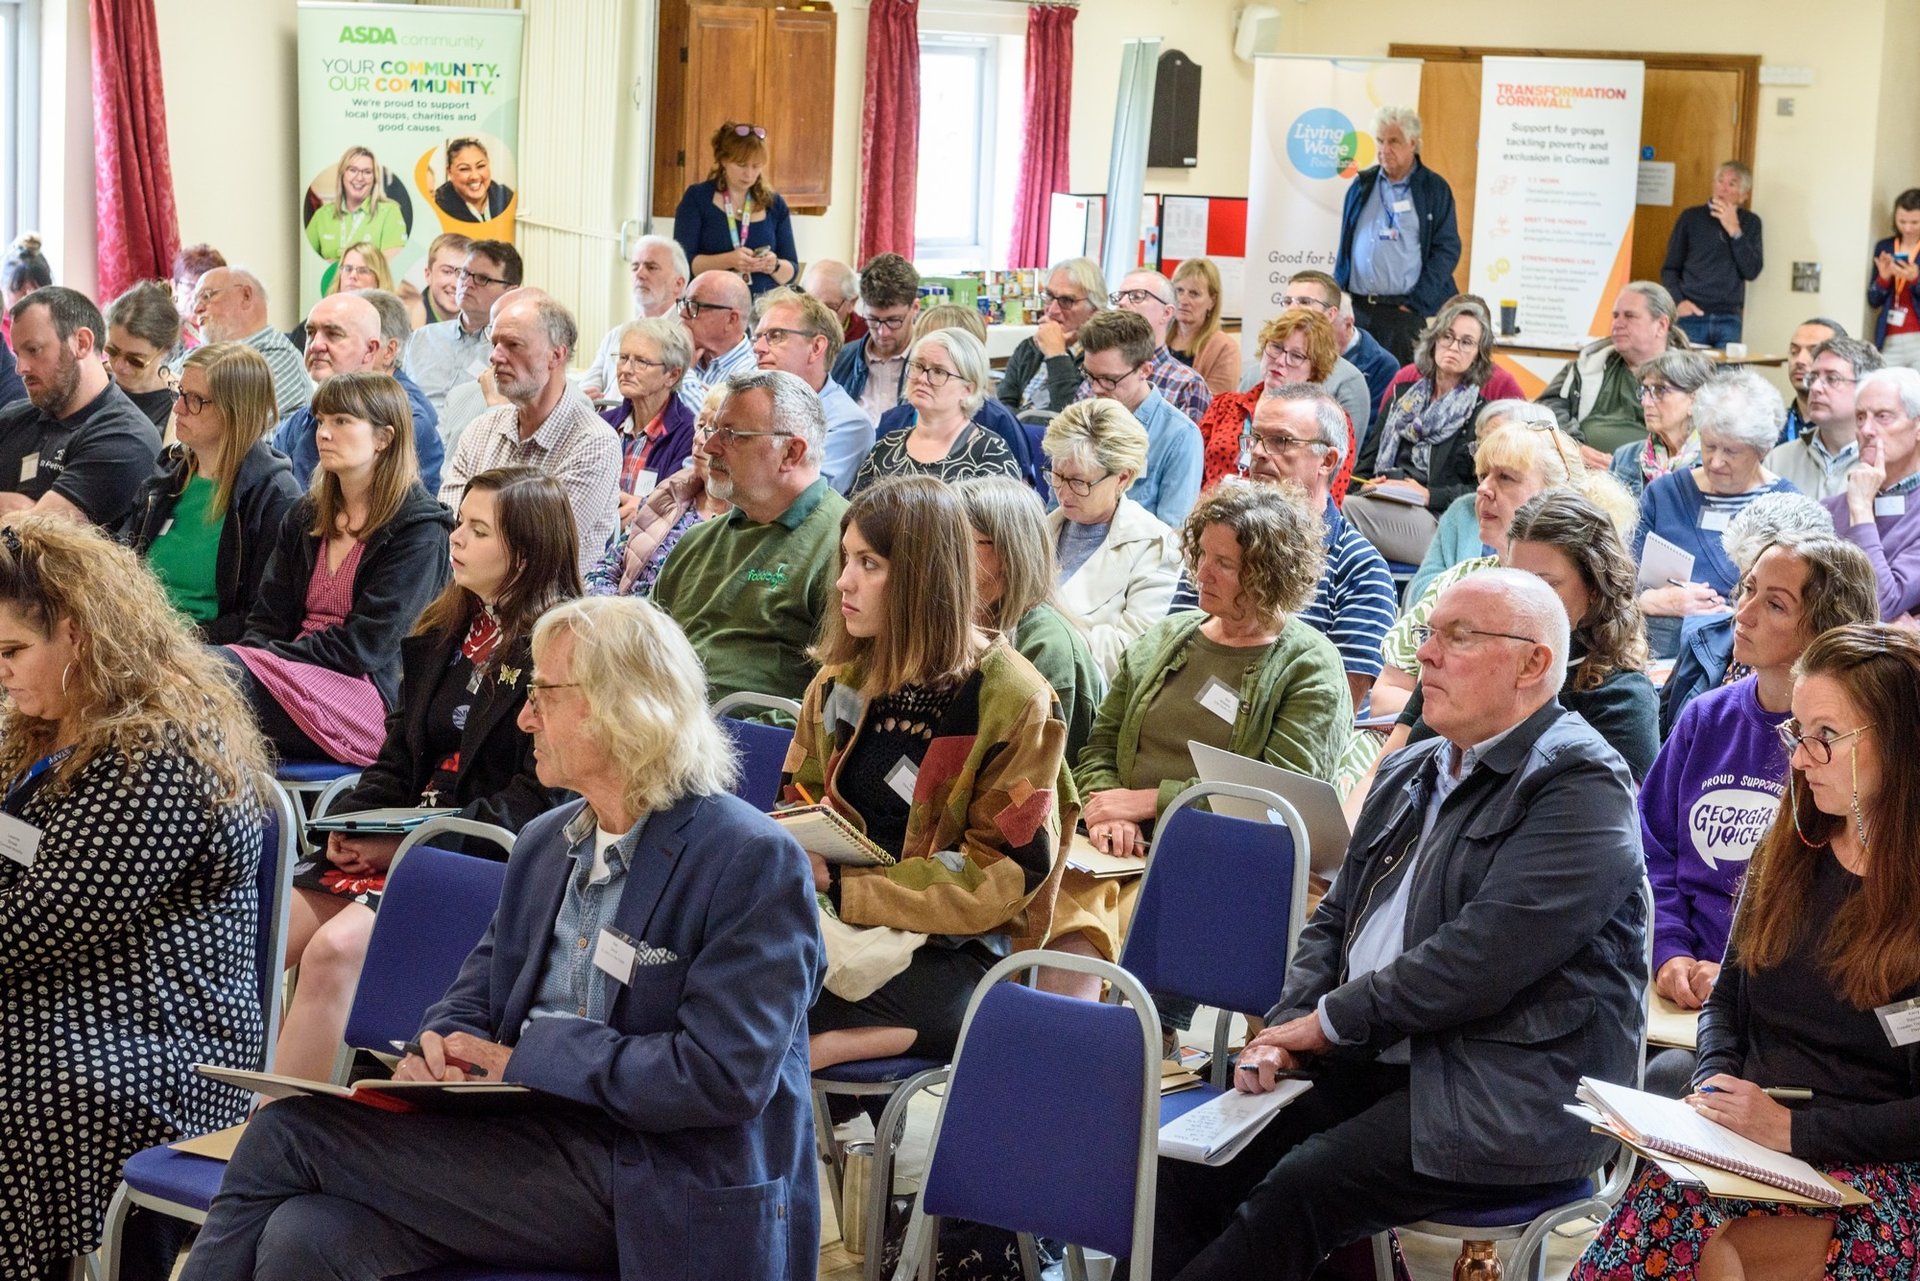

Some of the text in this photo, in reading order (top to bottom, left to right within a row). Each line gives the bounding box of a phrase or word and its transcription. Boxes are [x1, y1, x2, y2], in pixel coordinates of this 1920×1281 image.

[339, 26, 485, 50] ASDA community
[322, 58, 500, 78] YOUR COMMUNITY.
[329, 76, 495, 95] OUR COMMUNITY.
[1496, 83, 1626, 100] TRANSFORMATION
[352, 99, 470, 110] We're proud to support
[1496, 96, 1573, 109] CORNWALL
[345, 110, 477, 121] local groups, charities and
[378, 123, 444, 133] good causes.
[1294, 123, 1345, 145] Living
[1511, 122, 1605, 137] Support for groups
[1303, 139, 1350, 160] Wage
[1506, 137, 1608, 151] tackling poverty and
[1503, 153, 1610, 166] exclusion in Cornwall
[1268, 250, 1304, 264] Good
[1306, 251, 1325, 264] for
[1701, 774, 1784, 796] PROUD SUPPORTE
[1707, 825, 1761, 848] VOICE
